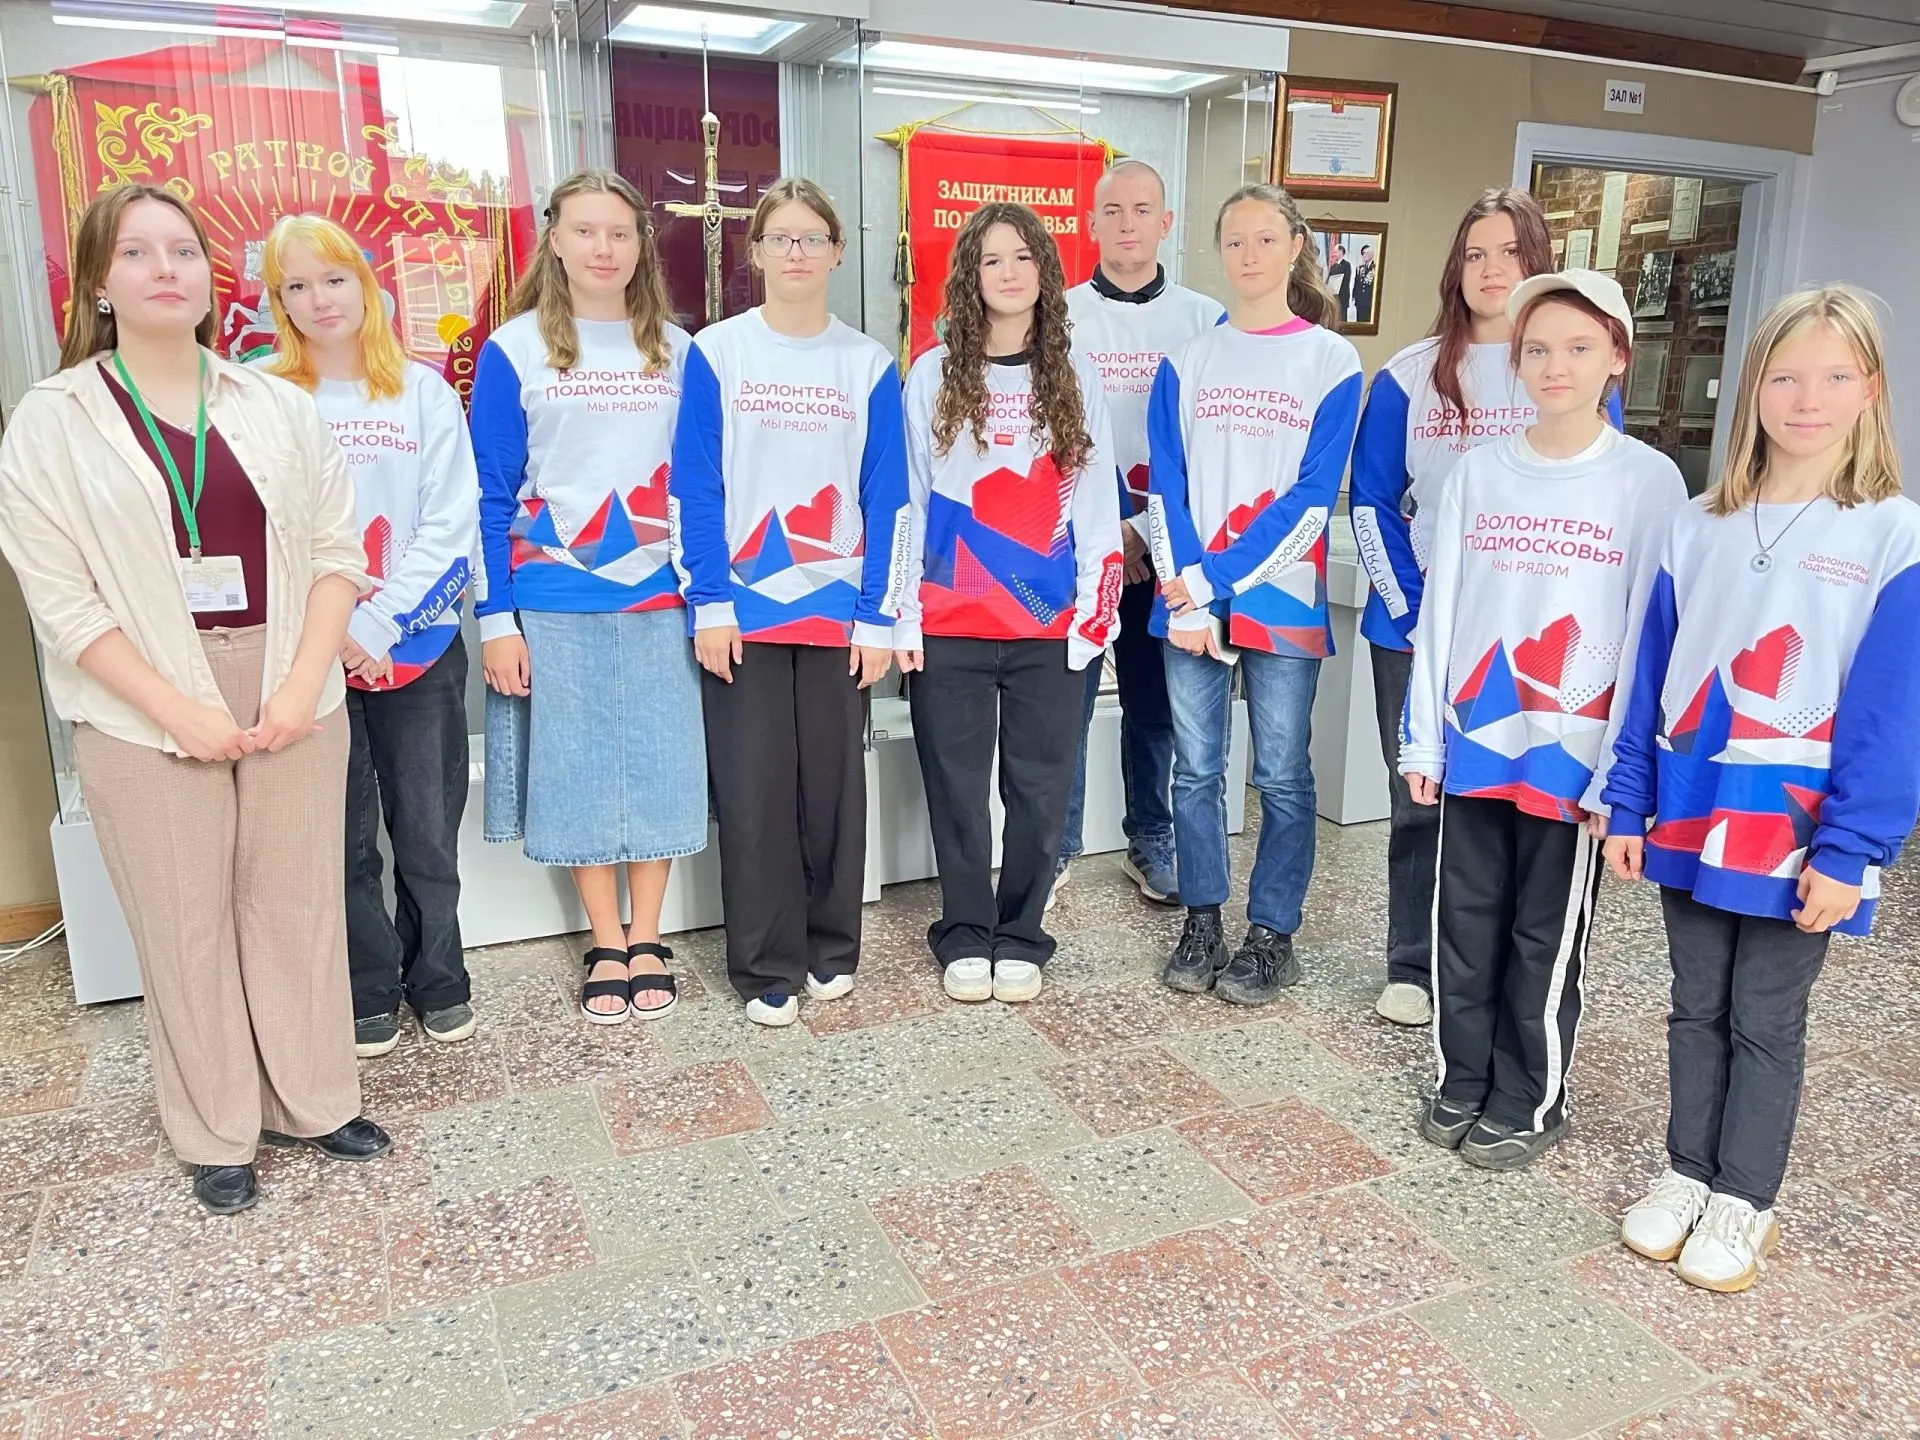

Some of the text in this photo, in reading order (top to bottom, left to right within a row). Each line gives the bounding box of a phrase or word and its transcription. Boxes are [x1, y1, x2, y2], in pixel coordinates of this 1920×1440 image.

[1610, 88, 1642, 105] ЗАЛ №1
[208, 140, 376, 189] РАТНОЙ
[938, 180, 1075, 206] ЗАЩИТНИКАМ
[558, 369, 674, 385] ВОЛОНТЕРЫ
[740, 380, 849, 404] ВОЛОНТЕРЫ
[1197, 387, 1303, 411] ВОЛОНТЕРЫ
[587, 401, 658, 413] МЫ РЯДОМ
[732, 399, 857, 424] ПОДМОСКОВЬЯ
[1194, 404, 1311, 432] ОДМОСКОВЬЯ
[1428, 407, 1535, 421] ВОЛОНТЕР
[760, 418, 828, 433] МЫ РЯДОМ
[1000, 425, 1030, 435] РЯДО
[1233, 424, 1275, 439] РЯДОМ
[1414, 424, 1525, 440] ПОДМОСКО
[347, 453, 378, 466] ДОМ
[1149, 501, 1165, 563] РЯДОМ
[1476, 513, 1614, 541] ВОЛОНТЕРЫ
[1356, 512, 1383, 576] РЯДОМ
[1464, 534, 1625, 567] ПОДМОСКОВЬЯ
[890, 515, 908, 607] ПОДМОСКОВЬЯ
[1491, 559, 1570, 578] МЫ РЯДОМ
[1798, 560, 1870, 585] ПОДМОСКОВЬЯ
[1808, 553, 1871, 575] ВОЛОНТЕРЫ
[443, 566, 466, 600] МЫ
